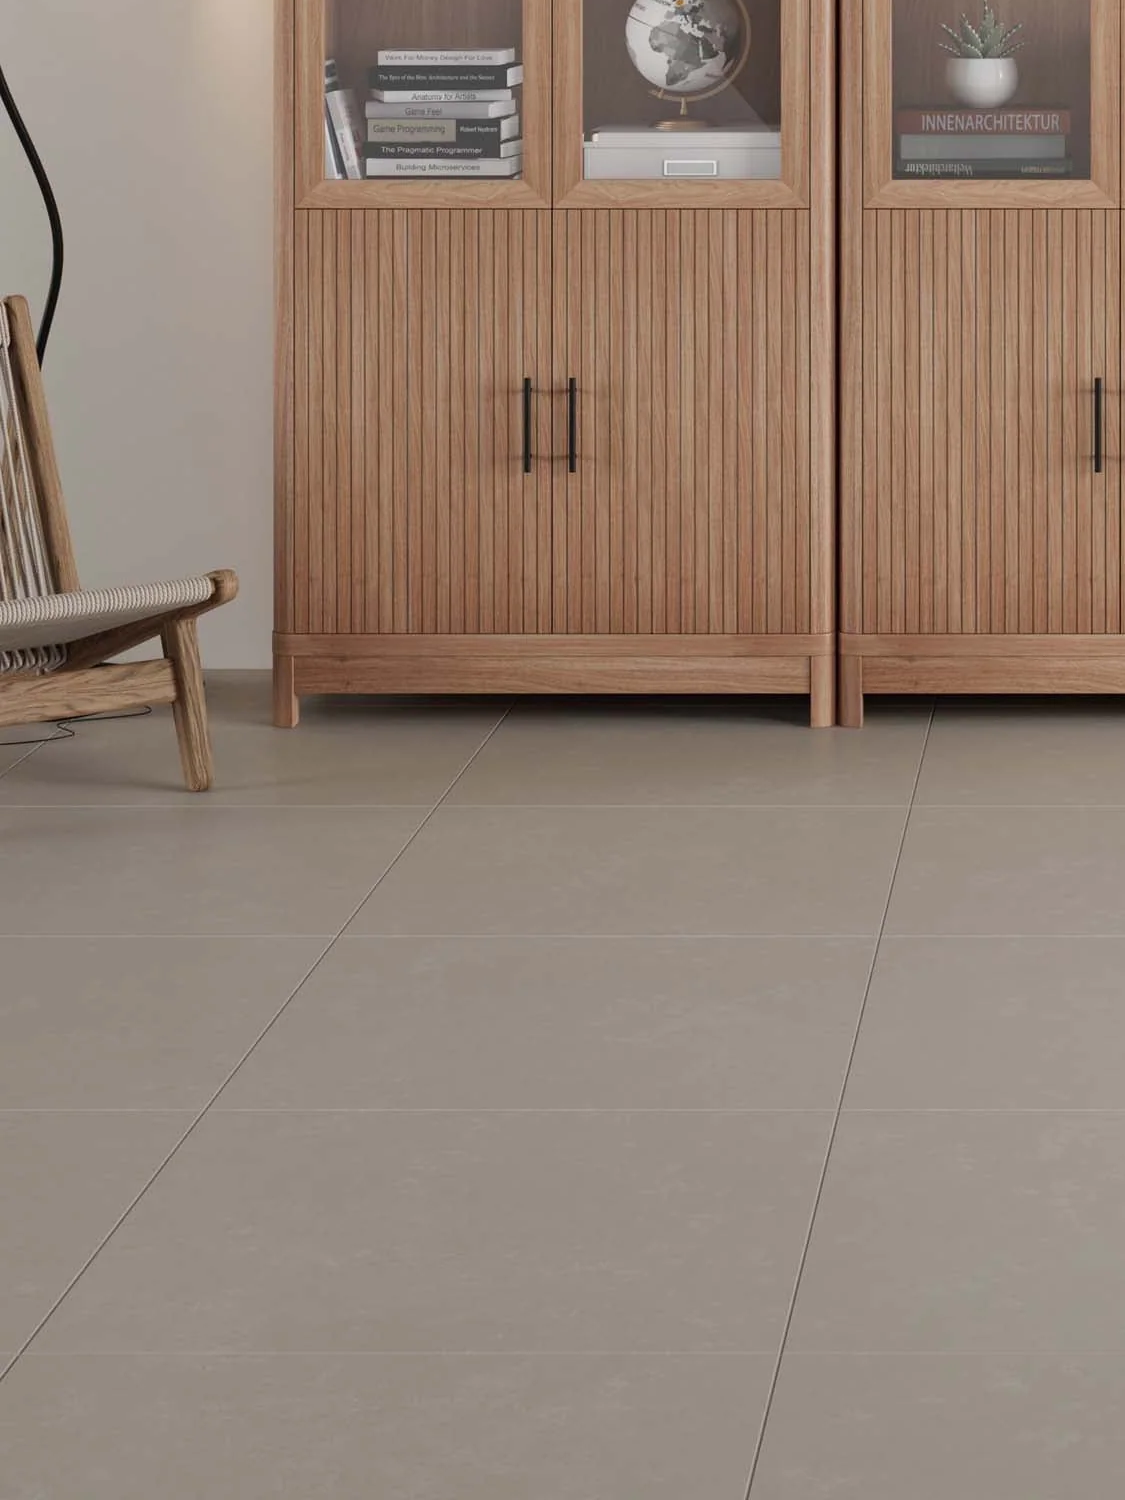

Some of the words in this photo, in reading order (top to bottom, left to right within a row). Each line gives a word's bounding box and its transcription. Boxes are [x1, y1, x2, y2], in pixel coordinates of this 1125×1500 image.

[411, 93, 443, 101] Anatomy
[405, 107, 425, 116] Game
[427, 107, 443, 116] Feel
[921, 113, 1060, 131] INNENARCHITEKTUR
[373, 125, 395, 133] Game
[397, 125, 445, 135] Programming
[397, 146, 434, 155] Pragmatic
[436, 146, 482, 155] Programmer
[396, 163, 427, 172] Building
[428, 163, 480, 171] Microservices
